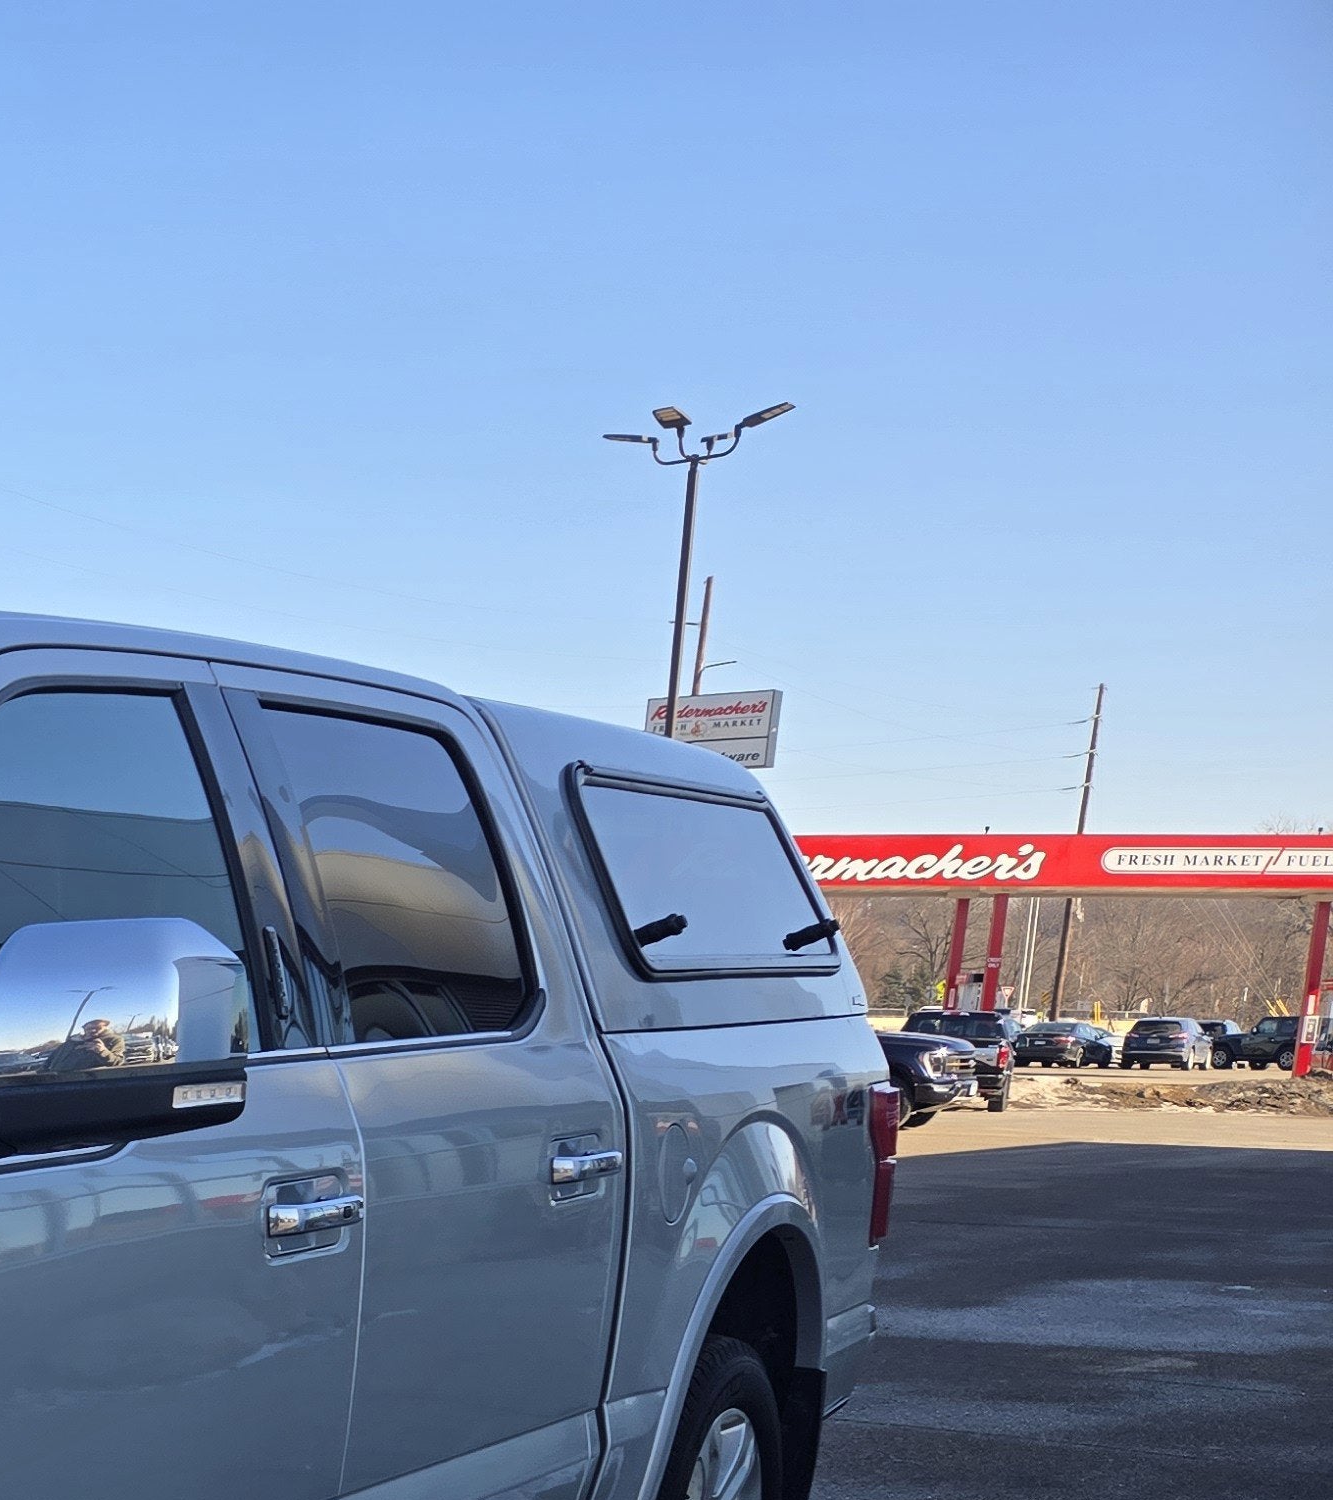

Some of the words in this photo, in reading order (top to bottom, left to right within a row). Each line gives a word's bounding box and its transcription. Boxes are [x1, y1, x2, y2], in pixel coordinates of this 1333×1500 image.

[651, 701, 768, 721] Rdermacher's
[653, 724, 687, 733] FRH
[713, 719, 762, 728] MARKET
[803, 843, 1046, 881] rmacher's
[1117, 854, 1175, 866] FRESH
[1183, 854, 1263, 867] MARKET
